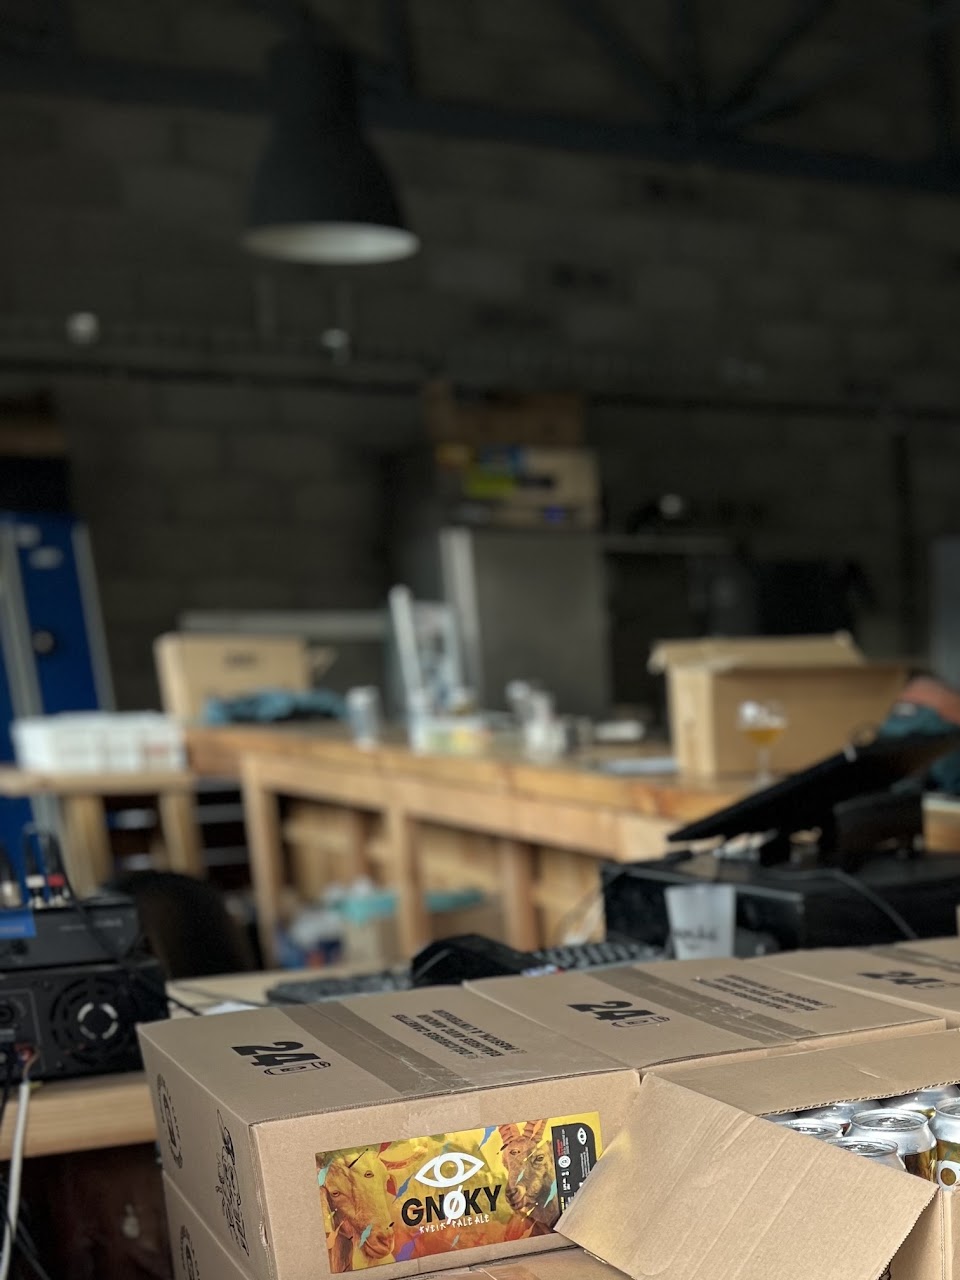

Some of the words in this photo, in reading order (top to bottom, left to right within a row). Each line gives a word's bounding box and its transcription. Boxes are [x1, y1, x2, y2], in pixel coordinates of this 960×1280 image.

[568, 1000, 657, 1022] 24
[231, 1041, 321, 1067] 24
[451, 1216, 473, 1228] PALE
[474, 1213, 490, 1224] ALE
